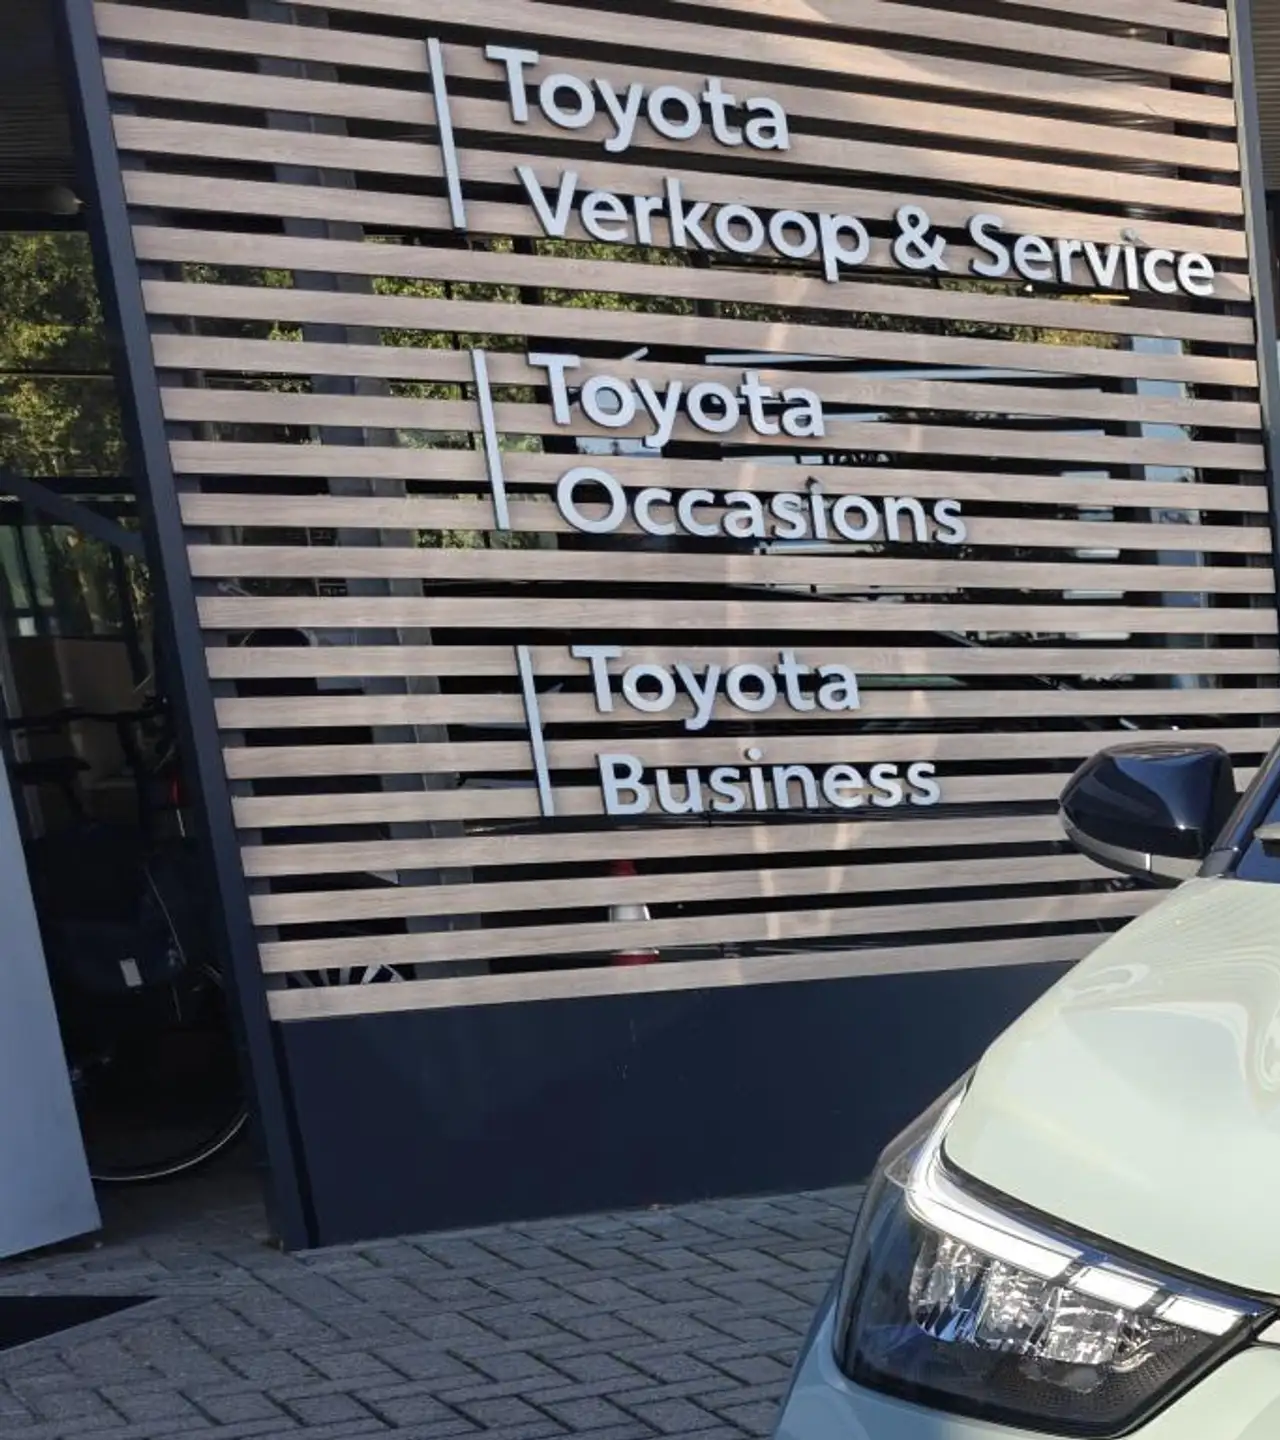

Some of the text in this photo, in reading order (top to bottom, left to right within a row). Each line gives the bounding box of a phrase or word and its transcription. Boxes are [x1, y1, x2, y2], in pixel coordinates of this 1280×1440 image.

[486, 45, 790, 153] Toyota
[515, 165, 1216, 297] Verkoop & Service
[528, 352, 826, 448] Toyota
[556, 466, 967, 544] Occasions
[572, 645, 862, 730] Toyota
[598, 748, 941, 816] Business
